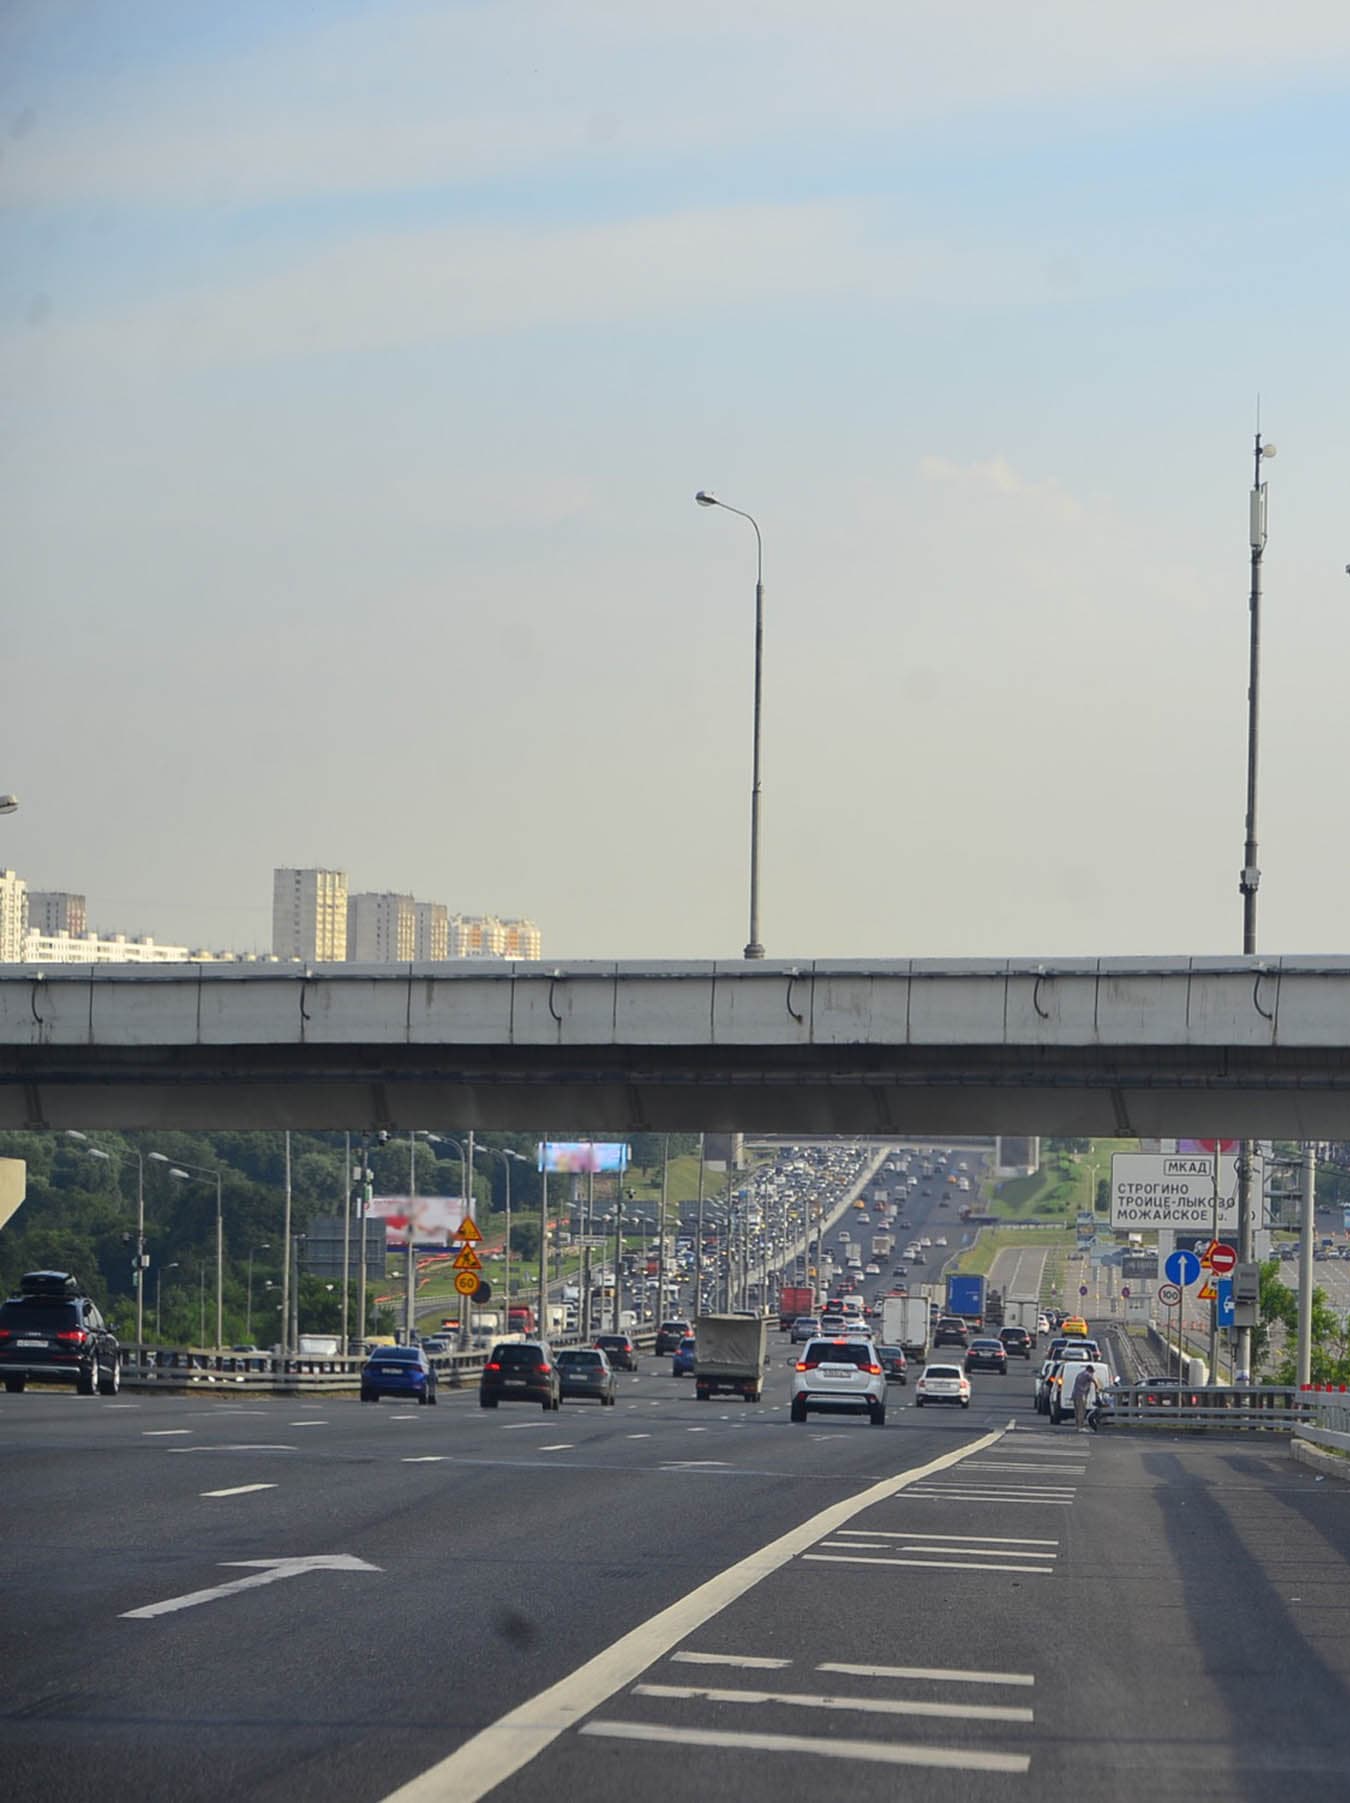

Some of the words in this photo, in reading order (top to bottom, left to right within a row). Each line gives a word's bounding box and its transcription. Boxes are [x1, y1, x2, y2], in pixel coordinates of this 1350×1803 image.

[1167, 1161, 1208, 1175] МКАД
[1117, 1183, 1190, 1196] СТРОГИНО
[1116, 1207, 1209, 1221] МОЖАЙСКОЕ
[459, 1278, 475, 1289] 60
[1162, 1289, 1179, 1300] 100
